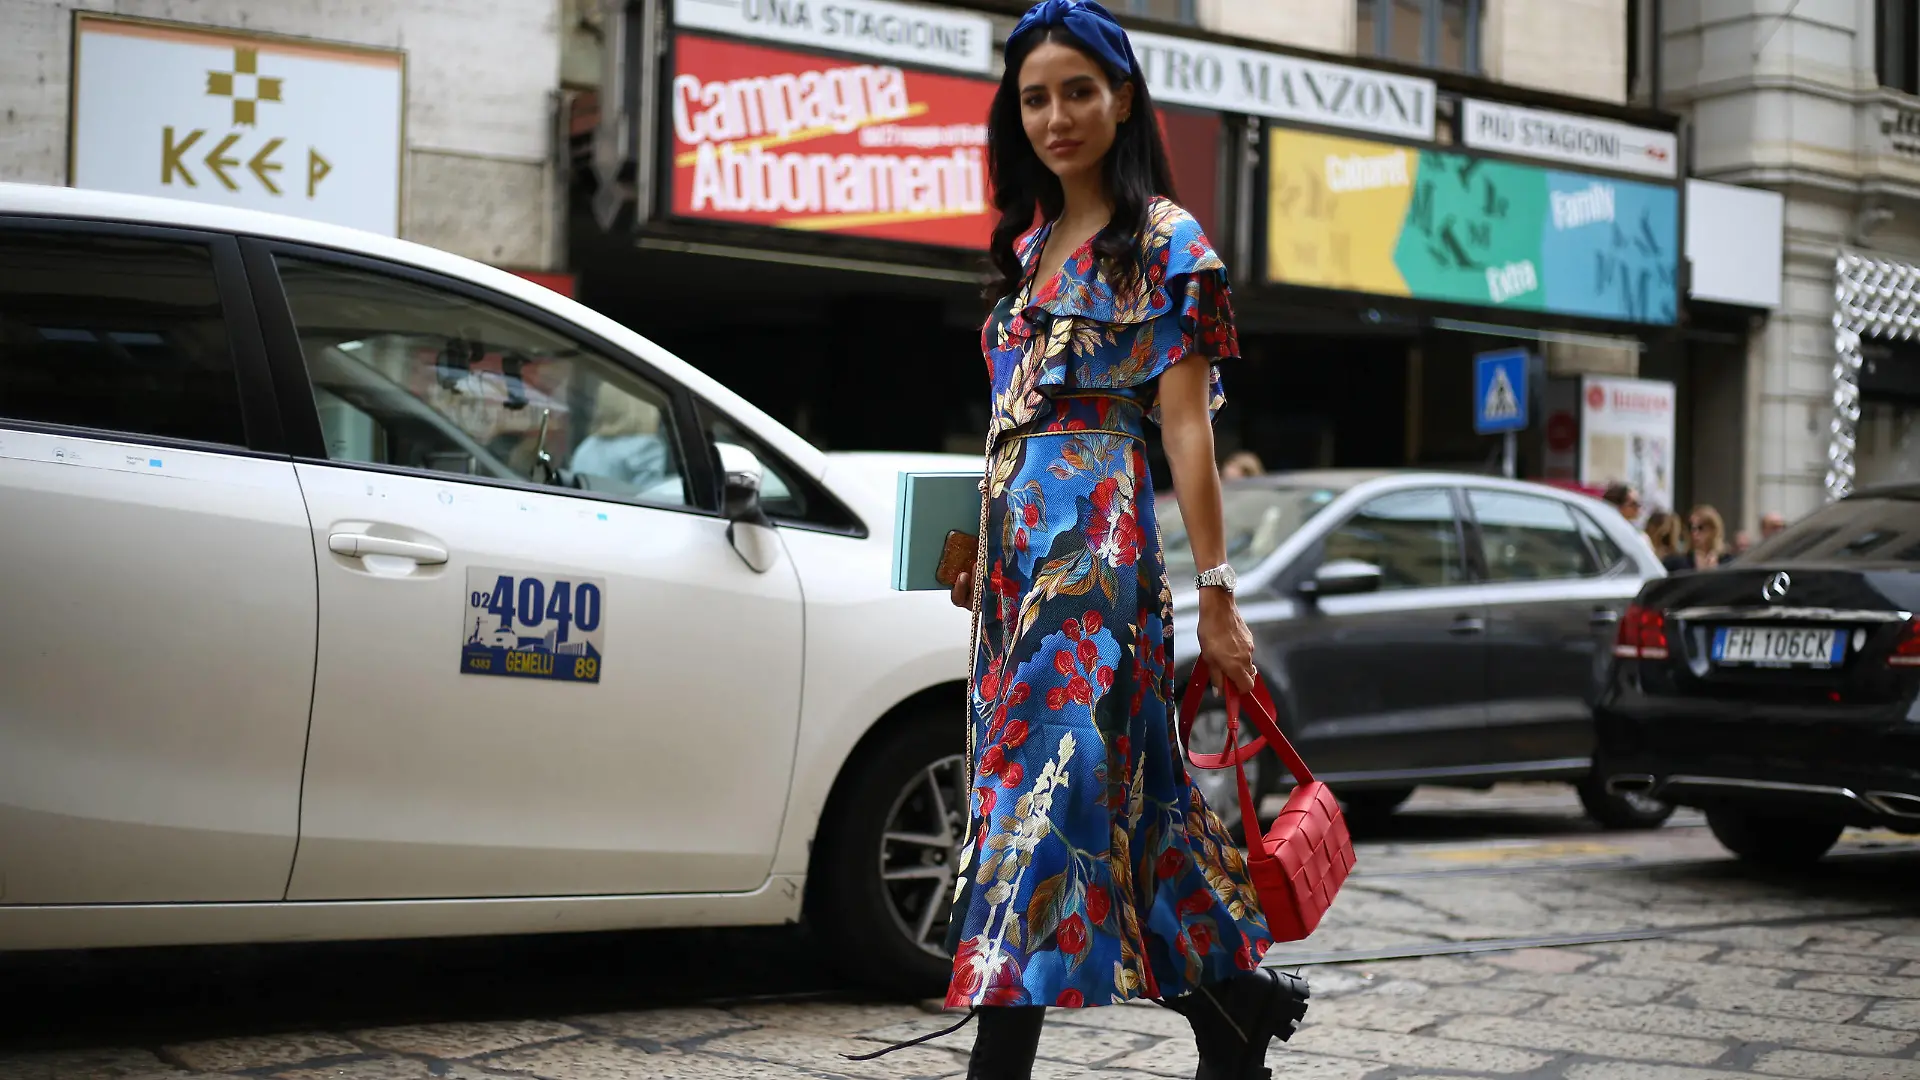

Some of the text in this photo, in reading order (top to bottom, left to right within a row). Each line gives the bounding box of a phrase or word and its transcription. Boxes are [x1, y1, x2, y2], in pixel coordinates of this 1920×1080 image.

[741, 0, 973, 56] UNA STAGIONE
[672, 65, 909, 145] Campagna
[1138, 44, 1425, 128] TRO MANZONI
[1518, 116, 1621, 160] STAGIONI
[690, 140, 985, 214] Abbonamenti
[1550, 182, 1616, 231] Family
[1485, 259, 1537, 303] Extra
[505, 651, 554, 675] GEMELLI
[573, 657, 598, 679] 89
[1726, 628, 1832, 659] FH 106CK
